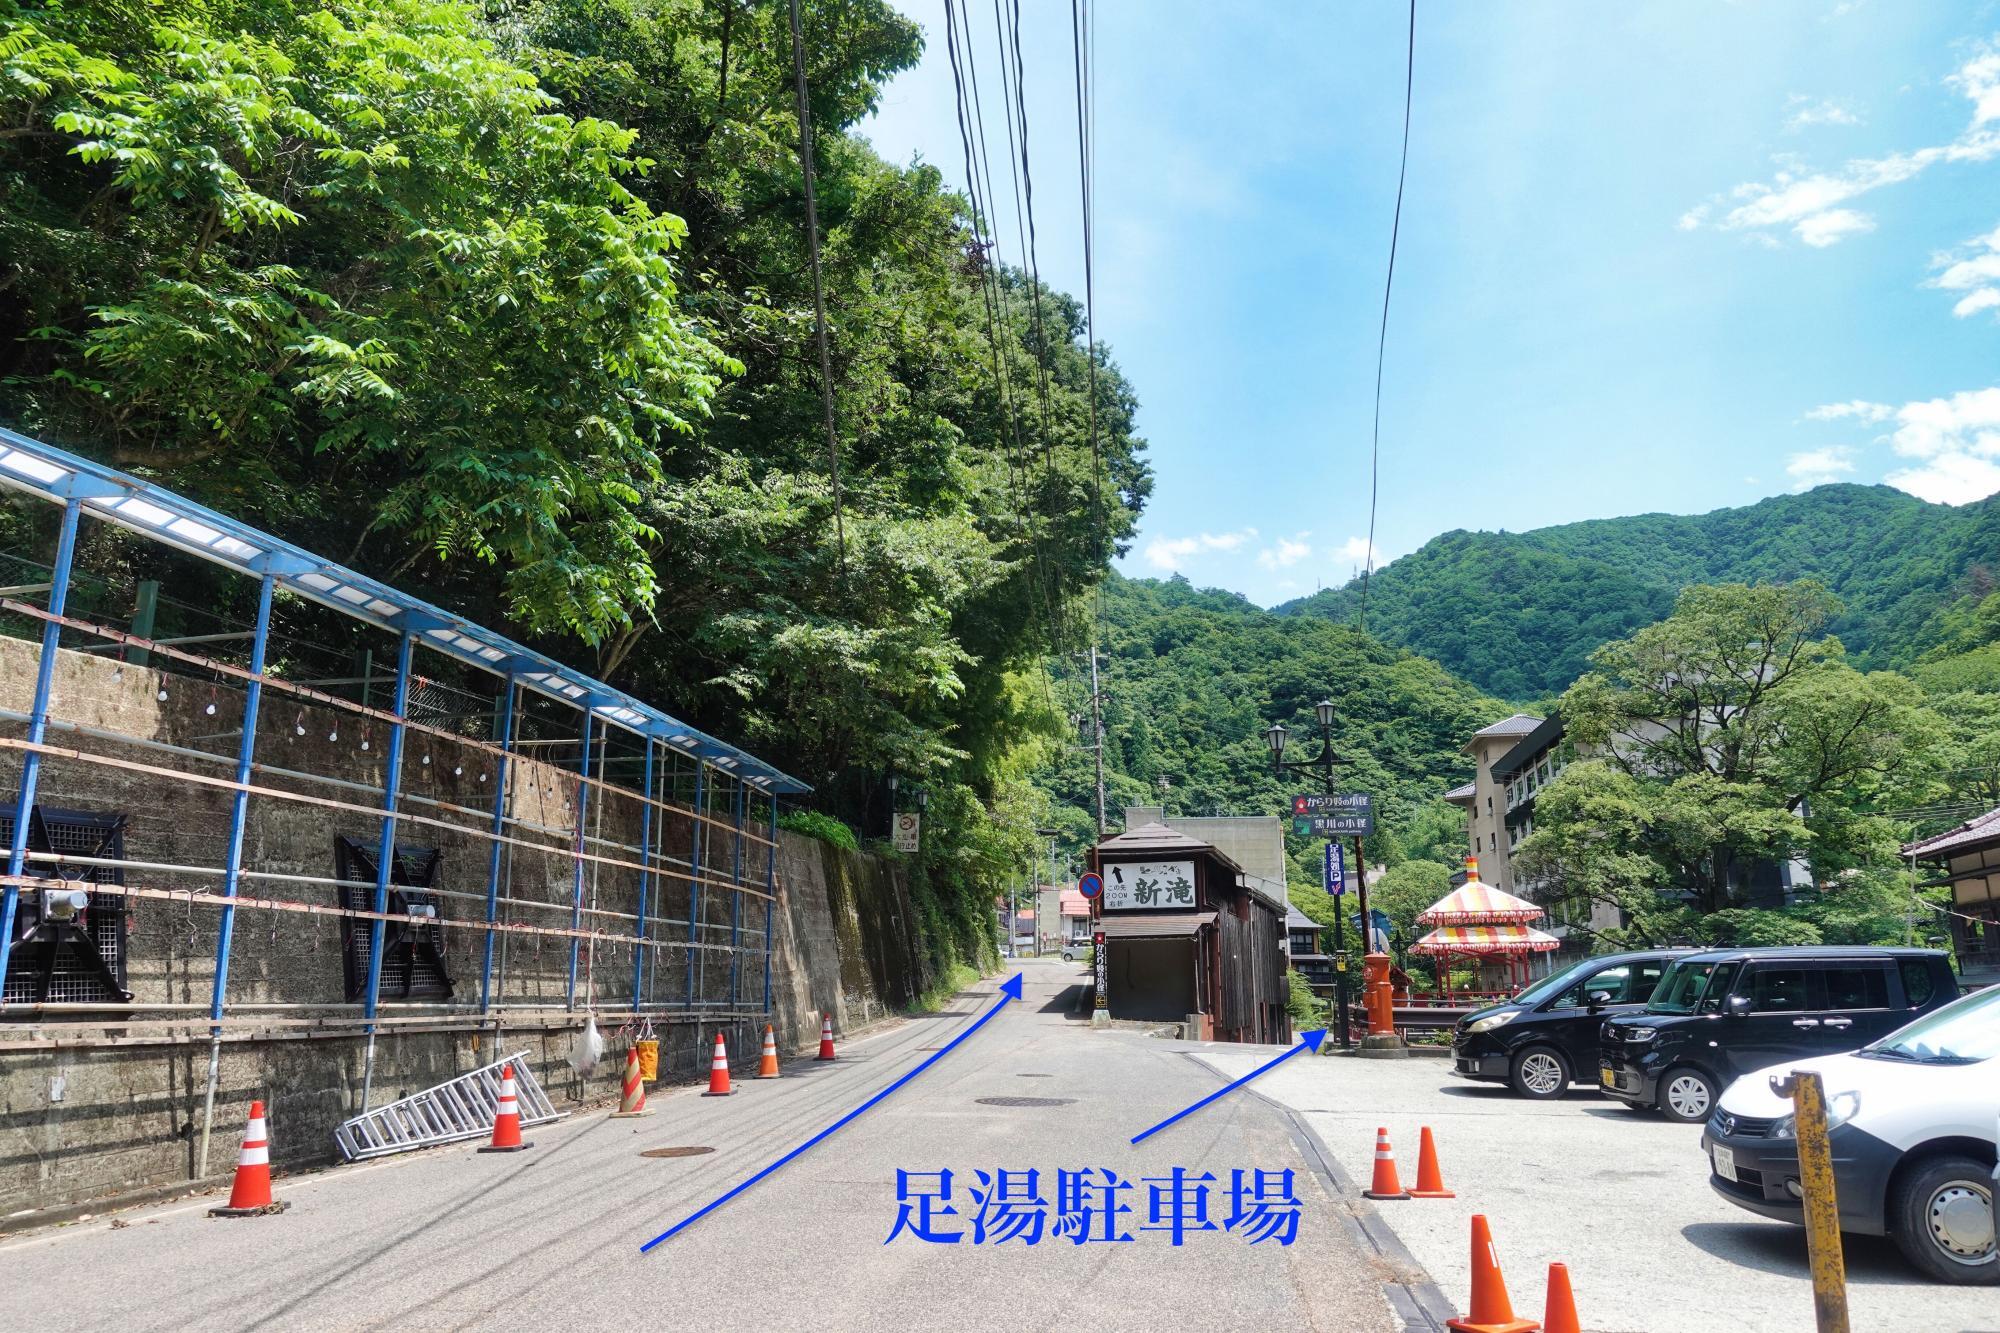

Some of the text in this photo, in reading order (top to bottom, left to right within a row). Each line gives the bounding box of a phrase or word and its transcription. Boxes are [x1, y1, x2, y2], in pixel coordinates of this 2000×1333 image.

[1315, 818, 1367, 829] 黒川の小径
[1108, 884, 1127, 892] この先
[1134, 877, 1194, 906] 新滝
